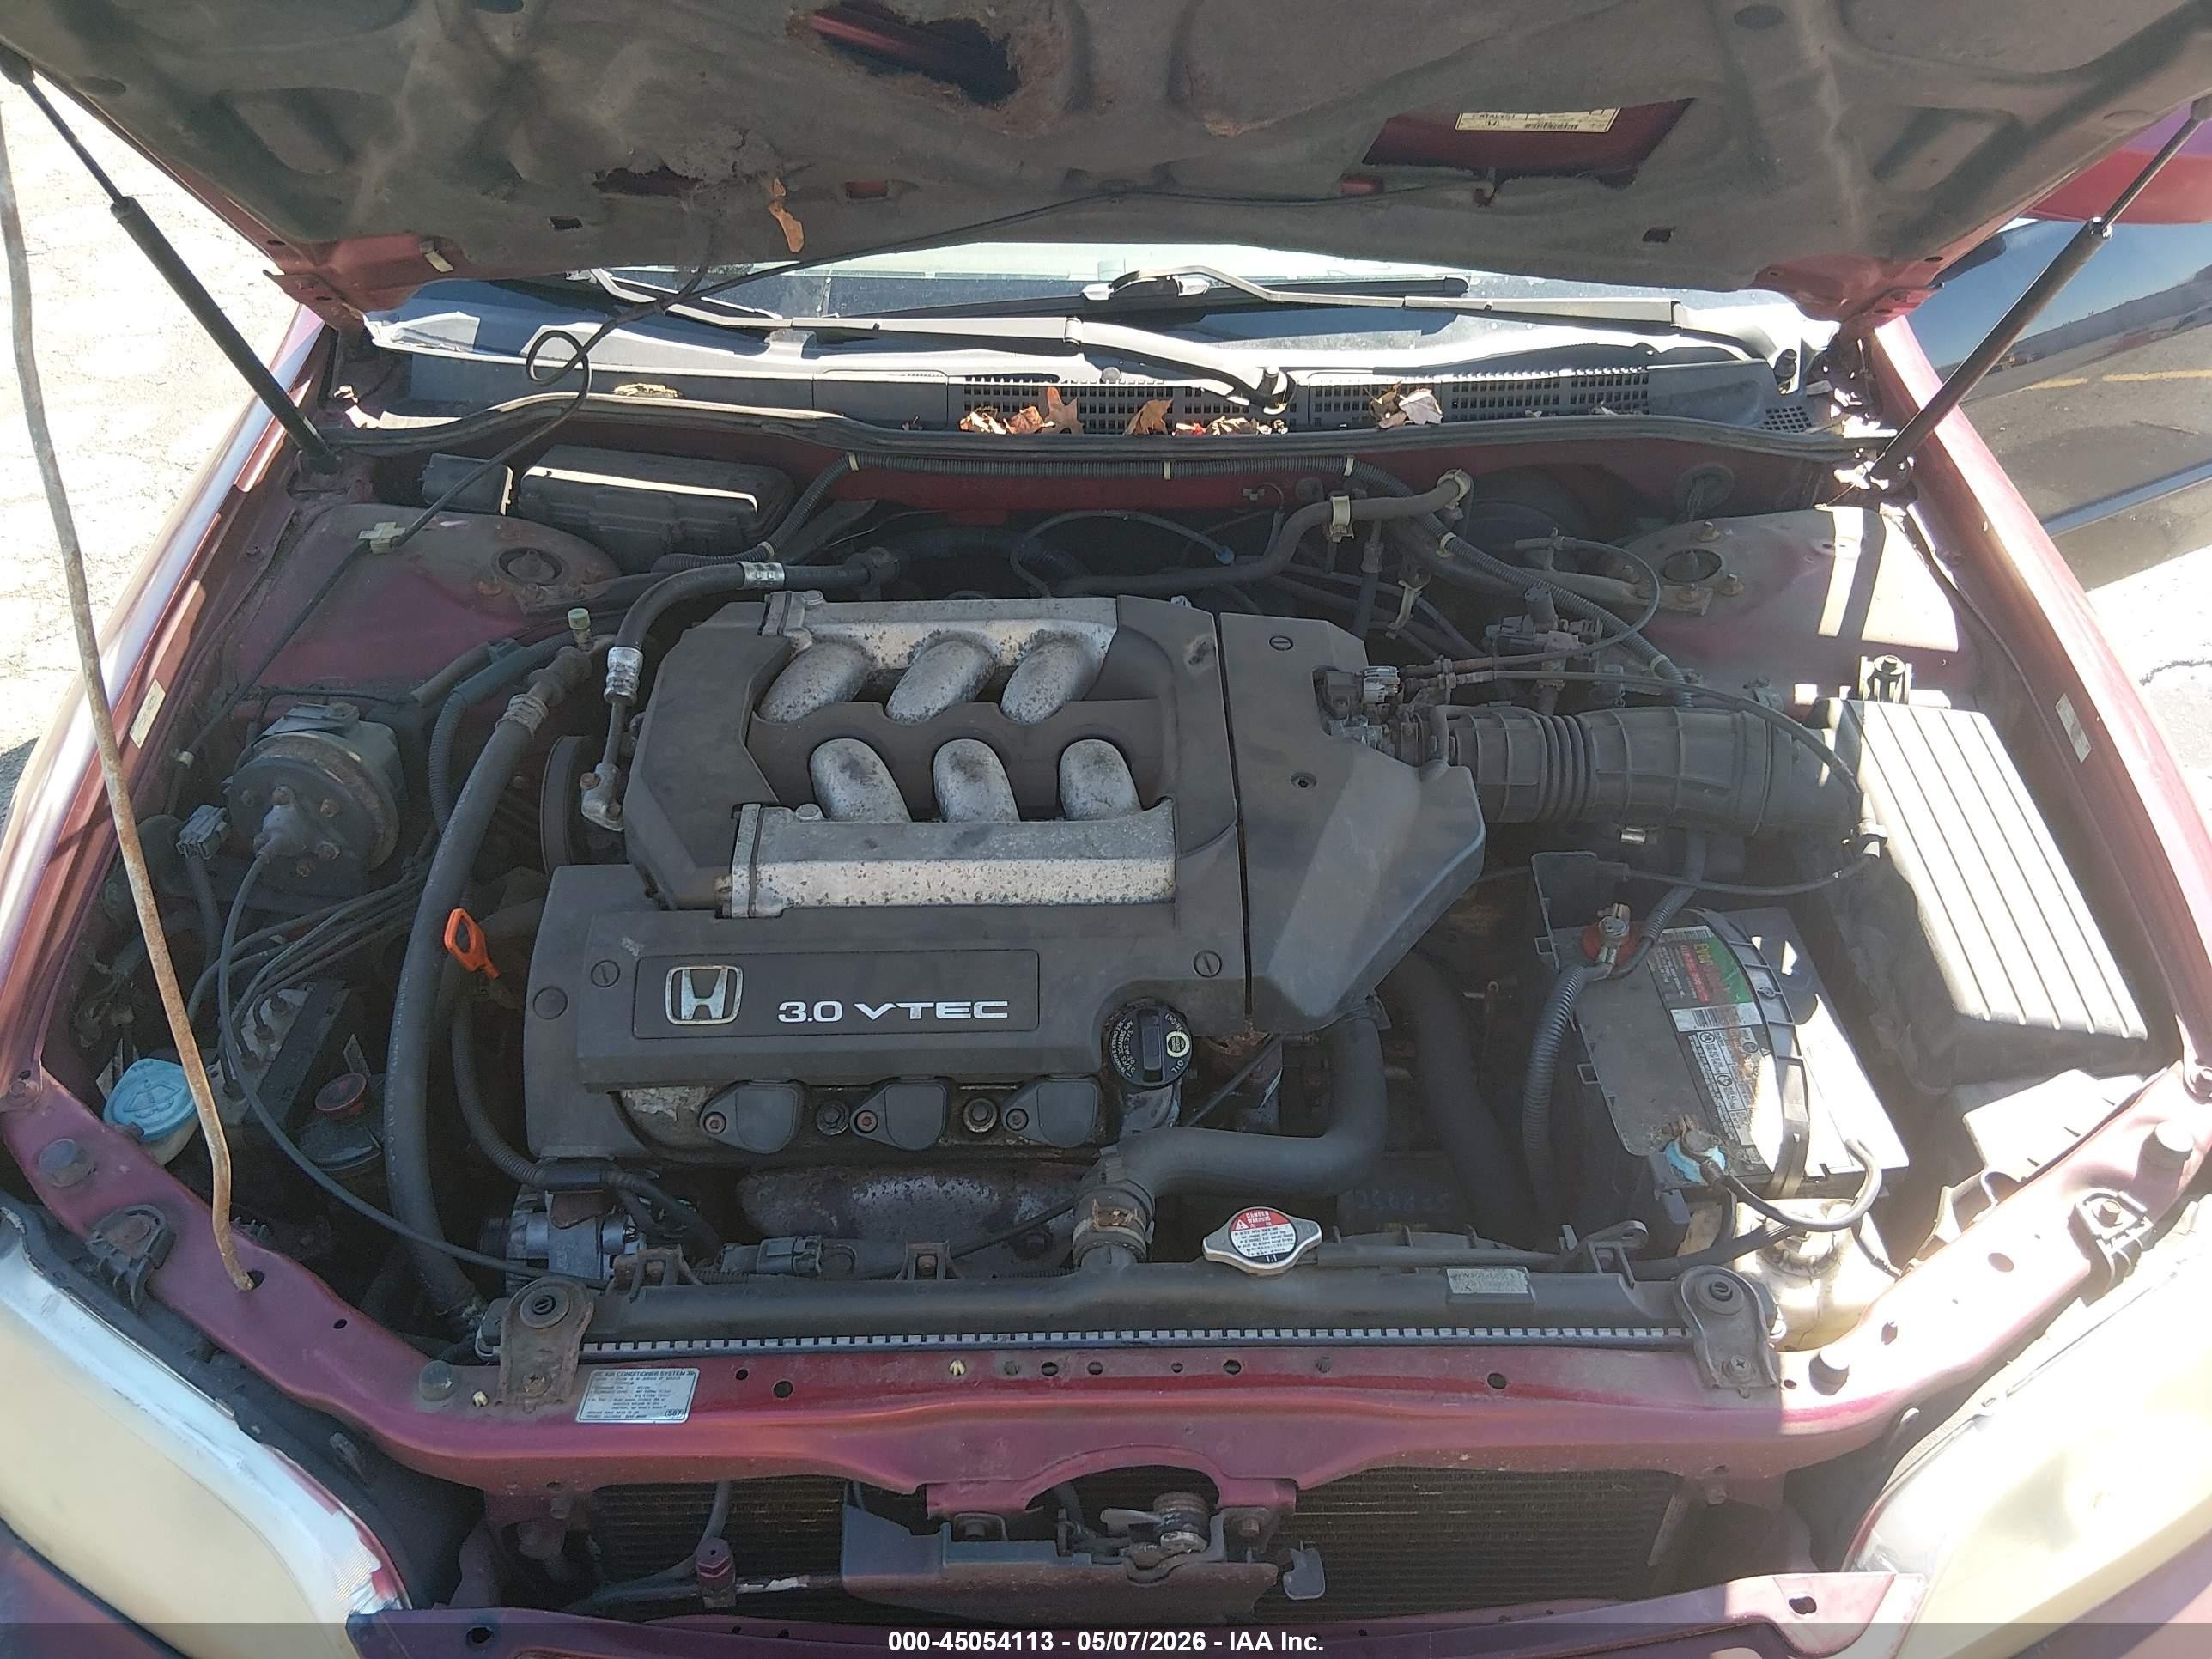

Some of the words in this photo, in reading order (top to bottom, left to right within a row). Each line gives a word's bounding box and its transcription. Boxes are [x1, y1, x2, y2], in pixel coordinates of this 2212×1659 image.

[777, 1000, 843, 1023] 3.0
[854, 1000, 1009, 1020] VTEC
[1165, 1013, 1183, 1031] ENGINE
[1170, 1060, 1184, 1073] OIL
